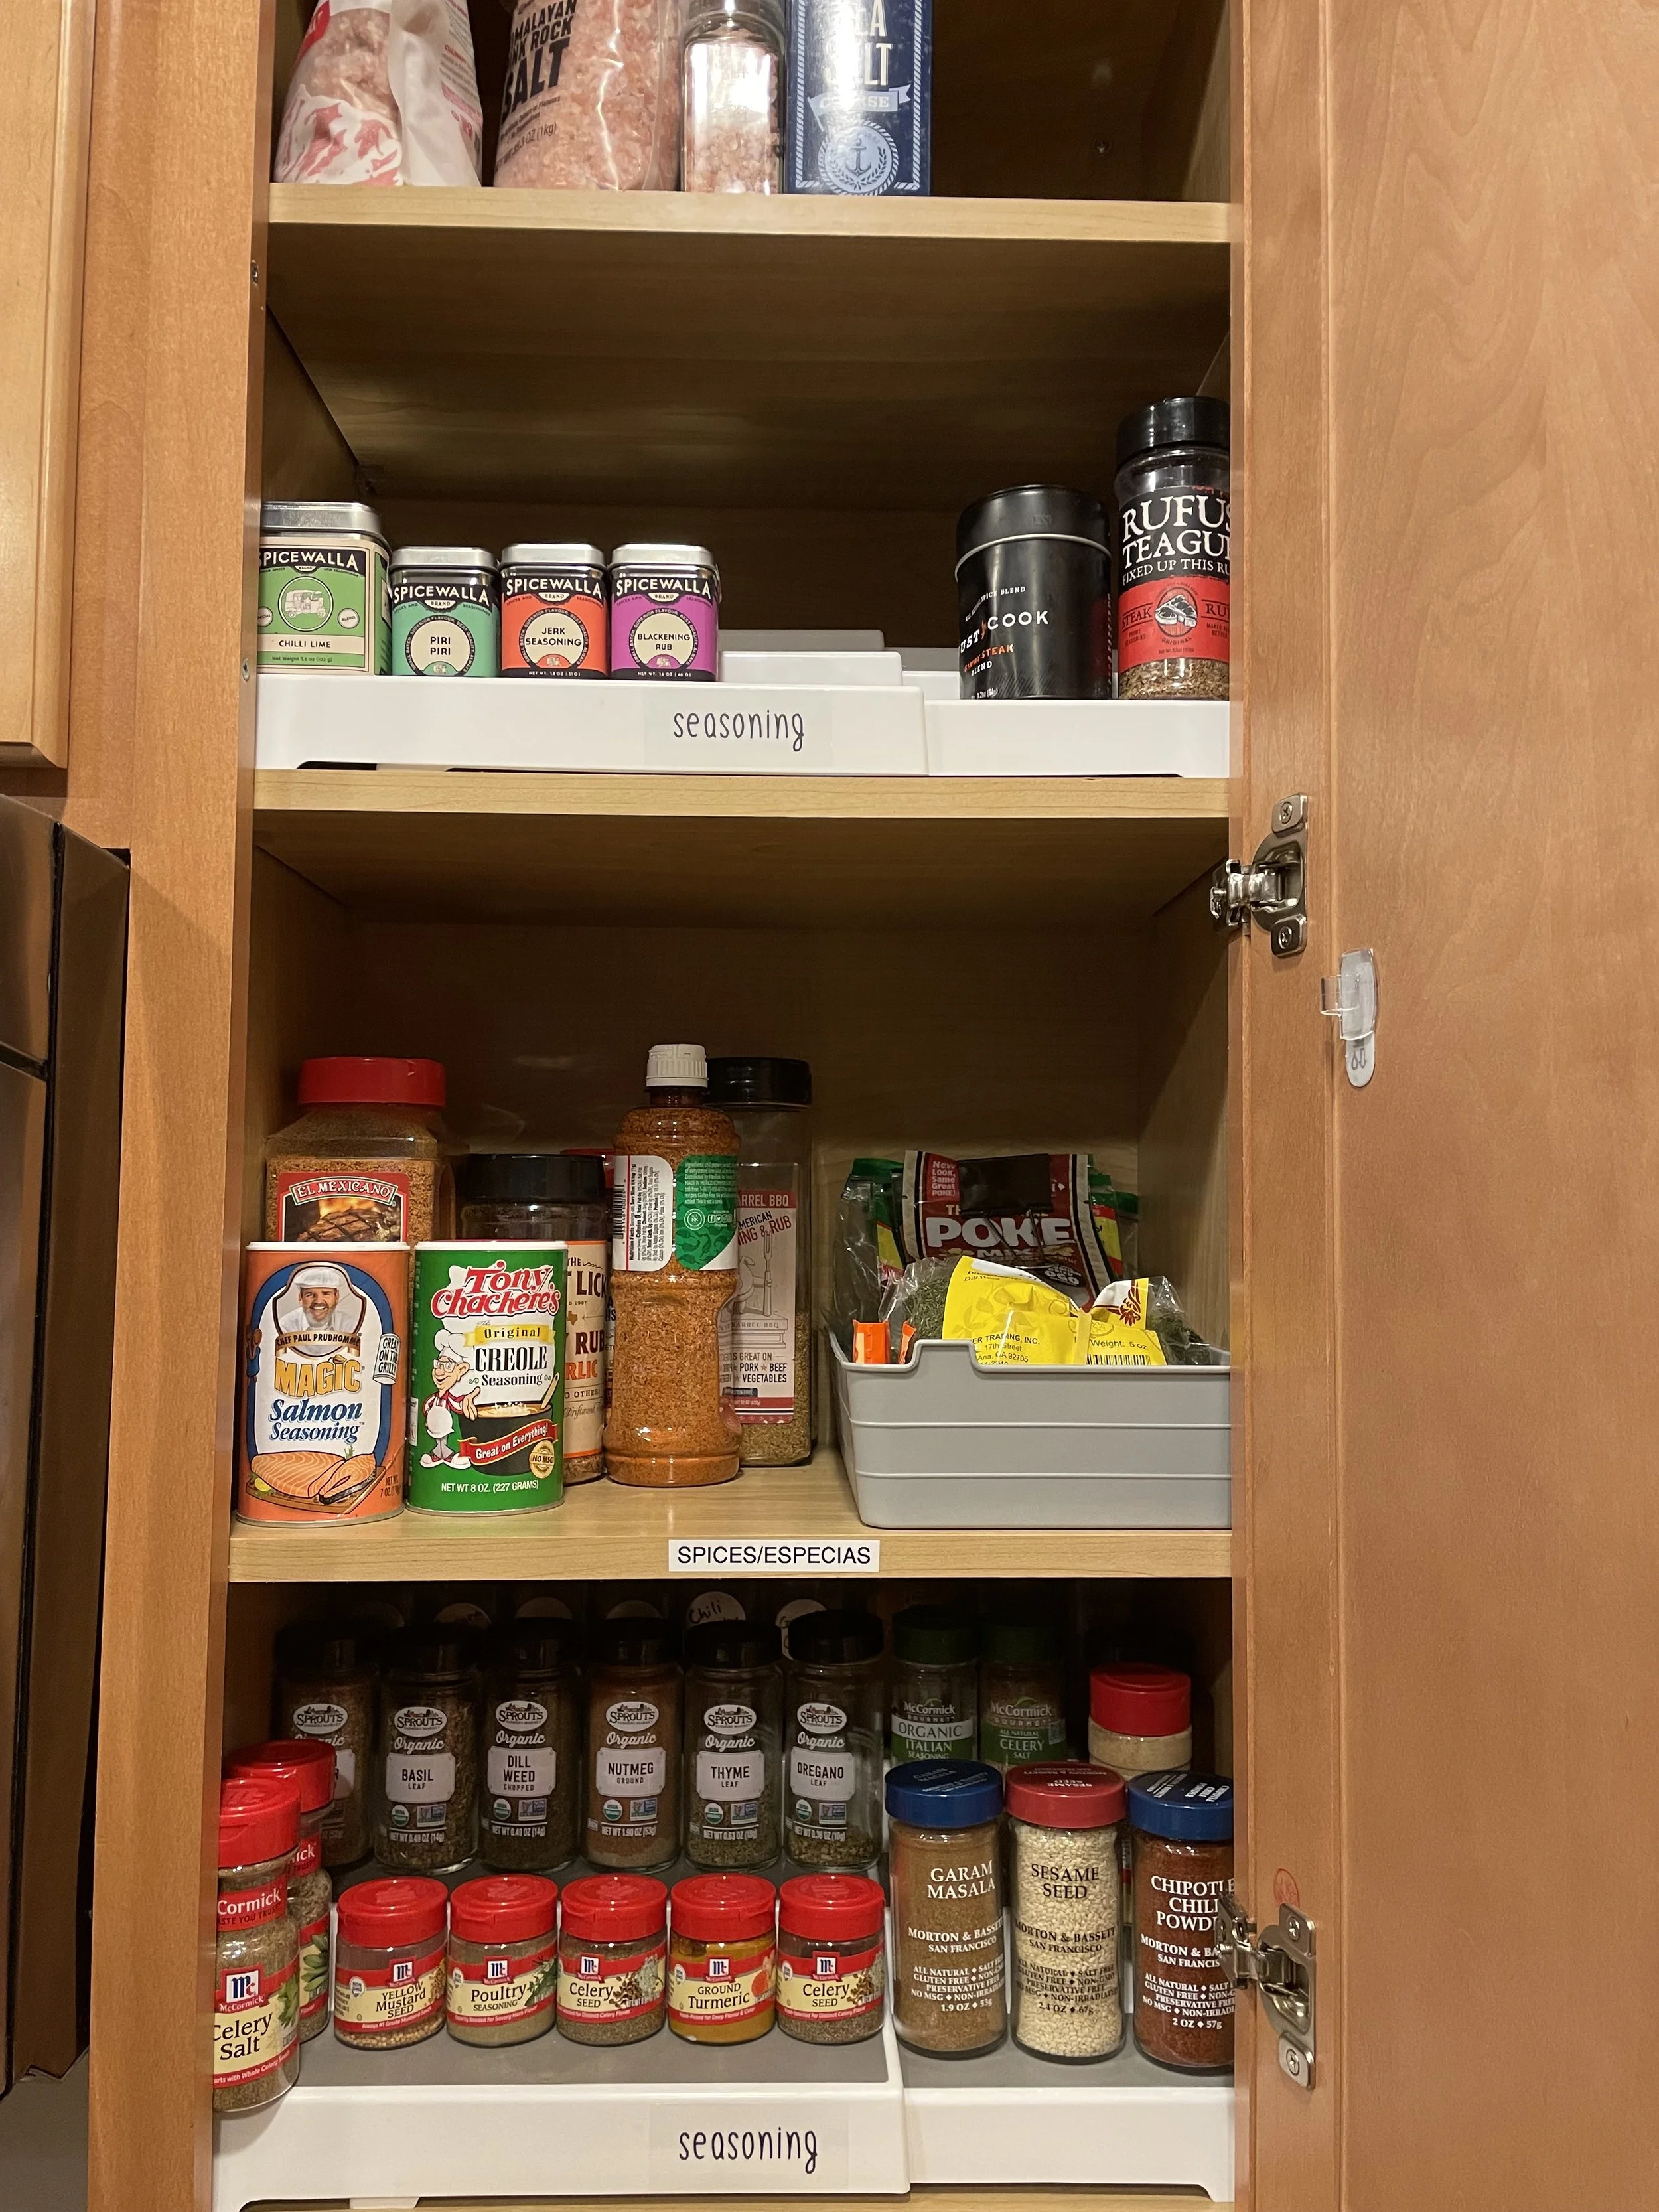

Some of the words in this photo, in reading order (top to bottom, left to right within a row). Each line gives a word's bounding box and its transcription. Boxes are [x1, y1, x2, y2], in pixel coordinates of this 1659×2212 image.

[530, 16, 574, 51] ROCK
[1122, 564, 1153, 586] FIXED
[1157, 559, 1177, 571] UP
[1181, 559, 1214, 571] THIS
[394, 586, 489, 607] SPICEWALLA
[506, 579, 602, 600] SPICEWALLA
[616, 579, 711, 599] SPICEWALLA
[1000, 586, 1026, 595] BLEND
[987, 611, 1048, 630] COOK
[1122, 607, 1153, 628] STEAK
[981, 644, 1014, 659] STEAK
[674, 709, 804, 751] seasoning
[297, 1185, 315, 1197] EL
[317, 1180, 390, 1197] MEXICANO
[770, 1195, 788, 1206] BBQ
[769, 1215, 792, 1234] RUB
[926, 1217, 1076, 1248] POKE
[464, 1260, 553, 1294] Tony
[277, 1335, 291, 1346] CHEF
[293, 1334, 311, 1343] PAUL
[313, 1334, 360, 1347] PRUDHOMME
[484, 1327, 540, 1339] Original
[575, 1329, 605, 1355] RUB
[1003, 1343, 1022, 1351] Street
[475, 1346, 547, 1372] CREOLE
[1009, 1353, 1029, 1363] 92705
[740, 1363, 758, 1372] PORK
[770, 1363, 787, 1372] BEEF
[274, 1358, 361, 1397] MAGIC
[481, 1373, 543, 1386] Seasoning
[742, 1374, 787, 1383] VEGETABLES
[269, 1399, 362, 1422] Salmon
[270, 1422, 359, 1443] Seasoning
[475, 1447, 499, 1460] Great
[501, 1443, 510, 1453] on
[512, 1423, 548, 1448] Everything!
[441, 1483, 457, 1492] NET
[457, 1483, 469, 1492] WT
[493, 1482, 510, 1493] (227
[512, 1480, 539, 1491] GRAMS)
[678, 1546, 871, 1564] SPICES/ESPECIAS
[689, 1600, 722, 1624] Chili
[904, 1701, 956, 1714] McCormick
[991, 1701, 1052, 1717] McCormick
[297, 1714, 344, 1726] SPROUTS
[397, 1717, 442, 1728] SPROUTS
[499, 1710, 543, 1722] SPROUTS
[609, 1712, 655, 1723] SPROUTS
[707, 1714, 753, 1727] SPROUTS
[800, 1712, 843, 1724] SPROUTS
[898, 1722, 962, 1739] ORGANIC
[394, 1737, 445, 1755] Organic
[496, 1730, 545, 1747] Organic
[607, 1731, 656, 1749] Organic
[705, 1735, 755, 1752] Organic
[798, 1731, 845, 1749] Organic
[905, 1740, 952, 1752] ITALIAN
[999, 1739, 1045, 1751] CELERY
[508, 1756, 531, 1767] DILL
[908, 1751, 949, 1759] SEASONING
[402, 1769, 433, 1781] BASIL
[504, 1769, 535, 1782] WEED
[609, 1763, 654, 1775] NUTMEG
[711, 1766, 750, 1779] THYME
[798, 1762, 844, 1779] OREGANO
[930, 1860, 993, 1882] GARAM
[1031, 1864, 1100, 1881] SESAME
[927, 1878, 995, 1899] MASALA
[1043, 1883, 1087, 1899] SEED
[239, 1912, 256, 1923] YOU
[908, 1927, 958, 1942] MORTON
[1074, 1926, 1116, 1943] BASSETT
[950, 1936, 997, 1953] FRANCISCO
[1029, 1939, 1046, 1950] SAN
[1048, 1944, 1102, 1953] FRANCISCO
[1141, 1933, 1188, 1956] MORTON
[1157, 1953, 1177, 1965] SAN
[914, 1966, 928, 1975] ALL
[930, 1968, 970, 1976] NATURAL
[979, 1962, 995, 1972] SALT
[1029, 1963, 1068, 1976] NATURAL
[913, 1974, 946, 1984] GLUTEN
[1027, 1978, 1086, 1994] PRESERVATIVE
[1087, 1984, 1105, 1992] FREE
[1078, 1972, 1115, 1986] NON-GMO
[1145, 1973, 1157, 1984] ALL
[1159, 1979, 1199, 1992] NATURAL
[382, 1981, 423, 2001] YELLOW
[471, 1984, 527, 2002] Poultry
[570, 1982, 614, 2001] Celery
[698, 1983, 741, 1995] GROUND
[803, 1983, 850, 1999] Celery
[926, 1982, 985, 1992] PRESERVATIVE
[1051, 1987, 1118, 2002] NON-IRRADIATED
[1145, 1980, 1175, 1997] GLUTEN
[1177, 1990, 1198, 2000] FREE
[376, 1988, 425, 2012] Mustard
[577, 1998, 601, 2008] SEED
[688, 1992, 750, 2009] Turmeric
[812, 1998, 838, 2007] SEED
[924, 1991, 944, 2000] MSG
[1155, 1994, 1217, 2008] PRESERVATIVE
[220, 1996, 264, 2012] McCormick
[388, 2004, 414, 2018] SEED
[473, 2000, 518, 2011] SEASONING
[1053, 2004, 1067, 2013] OZ
[1078, 2005, 1094, 2015] 67g
[1154, 2001, 1172, 2013] MSG
[1180, 2019, 1194, 2028] OZ
[1206, 2020, 1222, 2029] 57g
[220, 2035, 261, 2061] Salt
[228, 2073, 240, 2082] with
[242, 2067, 261, 2079] Whole
[679, 2127, 818, 2174] seasoning
